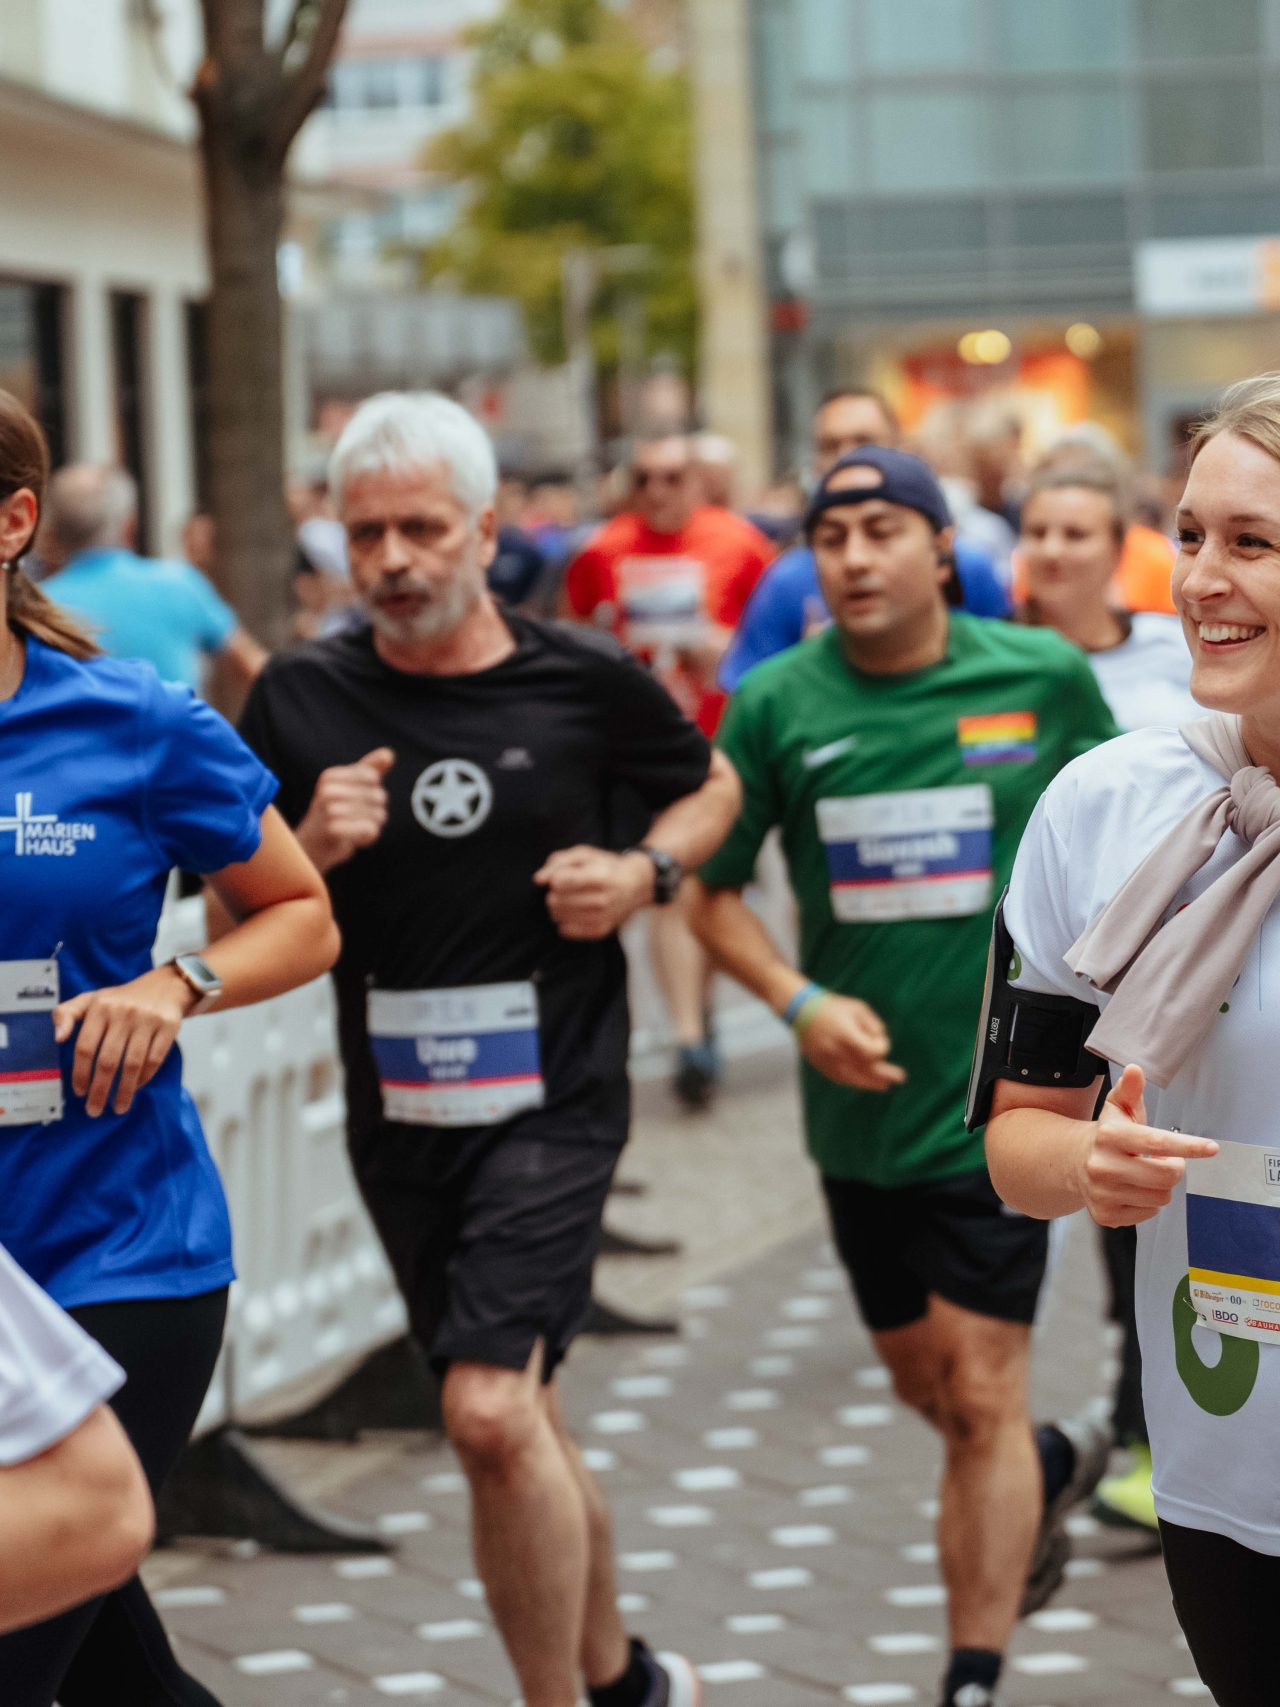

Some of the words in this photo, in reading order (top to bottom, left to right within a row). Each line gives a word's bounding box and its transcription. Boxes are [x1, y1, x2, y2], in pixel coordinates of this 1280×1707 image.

[25, 822, 96, 841] MARIEN
[25, 838, 76, 857] HAUS
[1215, 1309, 1239, 1323] BDO
